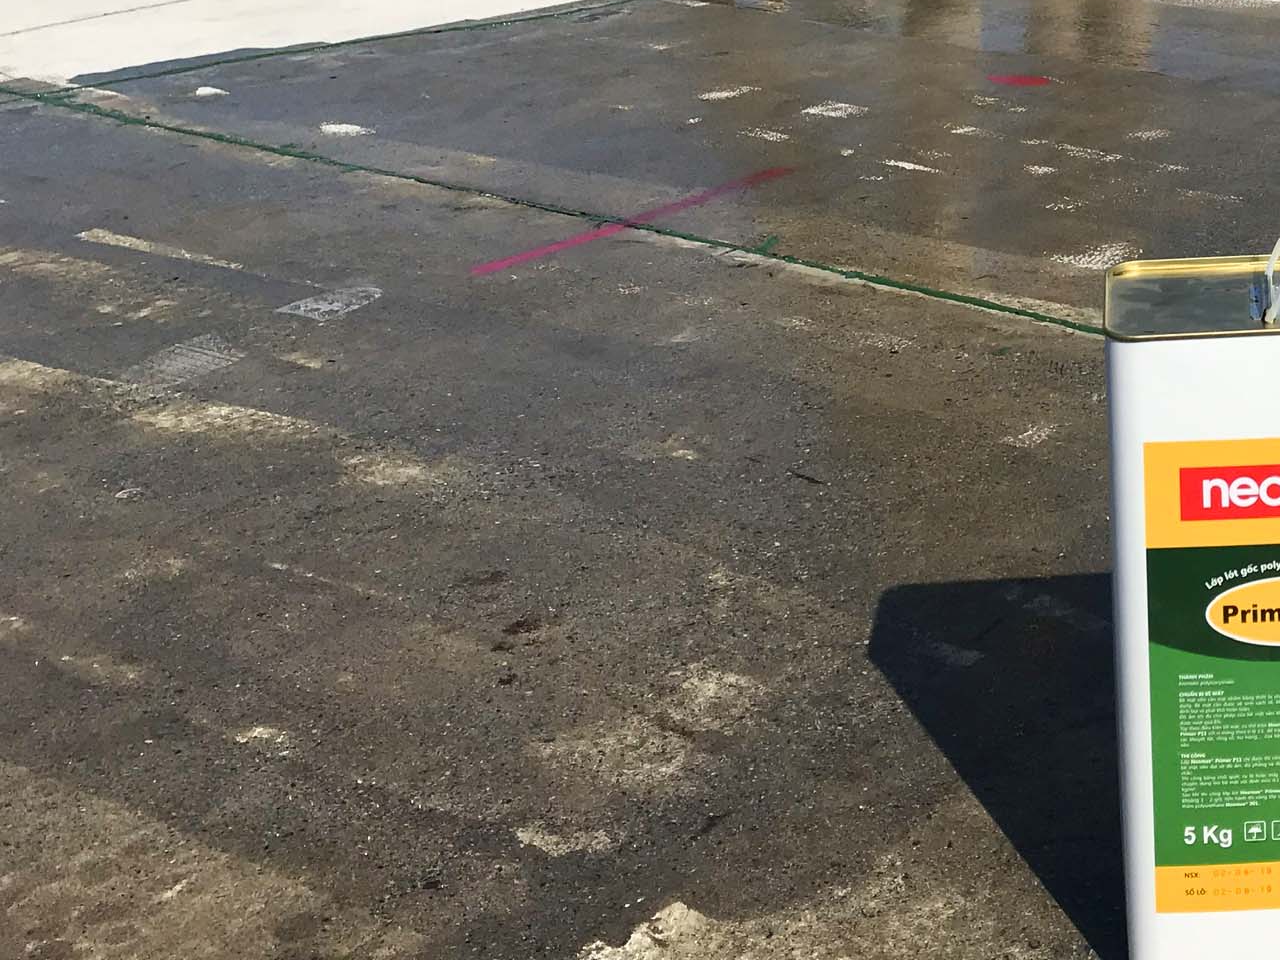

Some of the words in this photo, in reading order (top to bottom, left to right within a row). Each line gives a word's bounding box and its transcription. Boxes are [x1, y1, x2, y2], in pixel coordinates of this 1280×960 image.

[1204, 575, 1224, 590] Lớp
[1223, 569, 1239, 581] lót
[1240, 563, 1258, 578] gốc
[1183, 826, 1196, 845] 5
[1202, 825, 1233, 848] Kg
